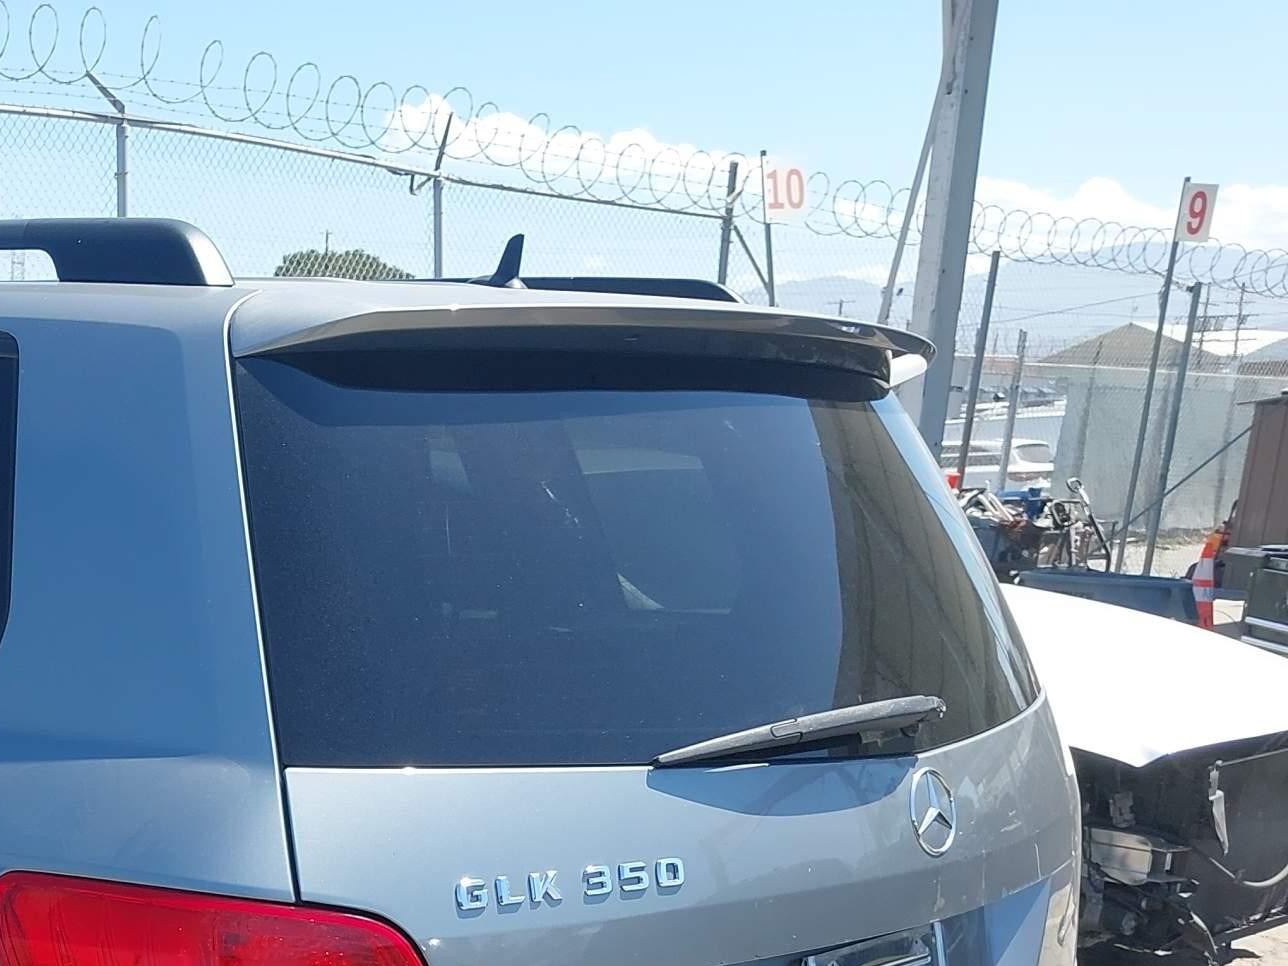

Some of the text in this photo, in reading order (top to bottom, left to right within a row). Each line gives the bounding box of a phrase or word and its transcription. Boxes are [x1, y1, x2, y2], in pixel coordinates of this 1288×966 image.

[766, 168, 805, 210] 10
[1186, 190, 1208, 236] 9
[455, 856, 686, 911] GLK 350
